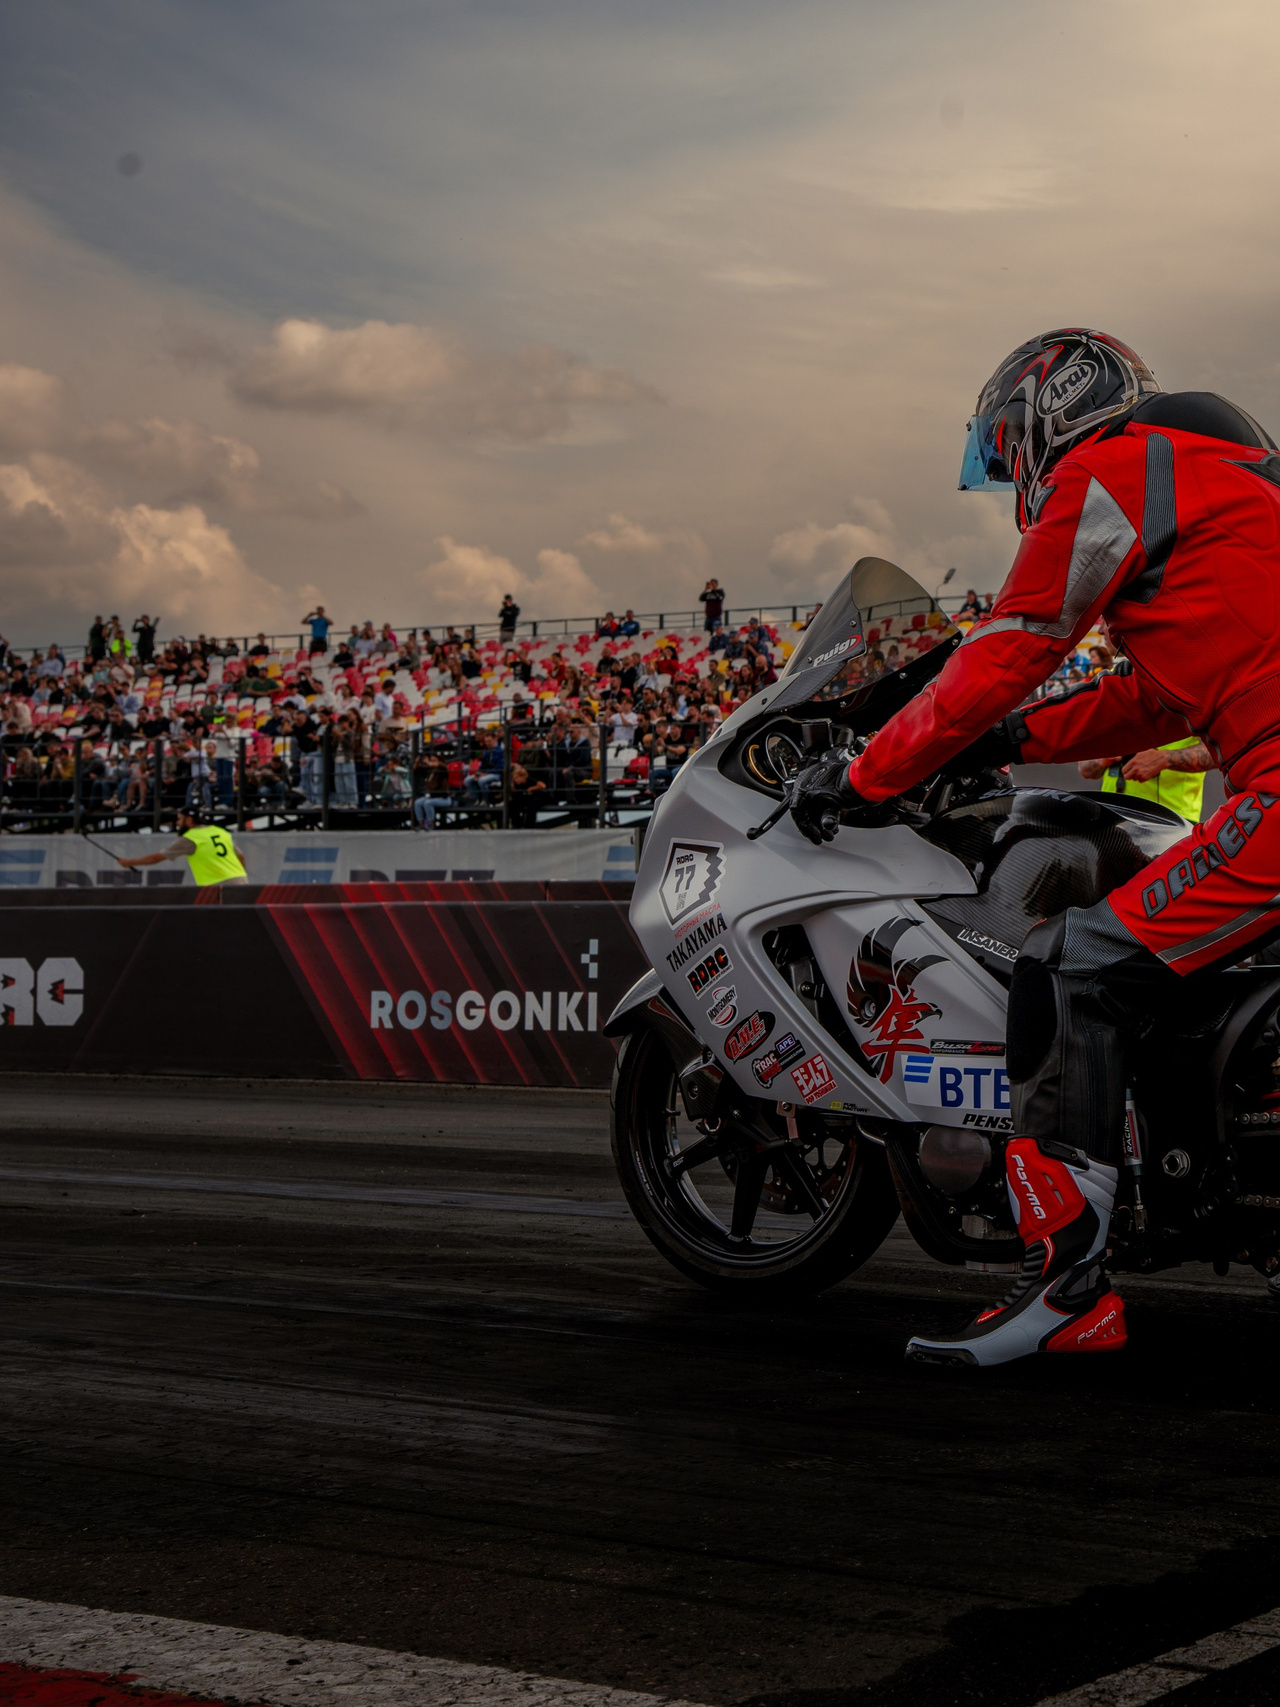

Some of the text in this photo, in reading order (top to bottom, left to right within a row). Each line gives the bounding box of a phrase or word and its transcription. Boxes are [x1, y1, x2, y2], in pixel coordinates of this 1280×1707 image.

[1047, 362, 1088, 412] Arai
[979, 787, 1077, 803] SUZUKI
[211, 835, 228, 857] 5
[675, 864, 696, 893] 77
[666, 912, 728, 972] TAKAYAMA
[687, 947, 729, 993] RDRC
[370, 990, 598, 1032] ROSGONKI
[708, 987, 736, 1020] MONTGOMERY
[728, 1014, 765, 1060] D.M.E.
[779, 1036, 796, 1053] APE
[756, 1053, 778, 1073] TRAC
[792, 1055, 831, 1097] ヨシムラ
[962, 1113, 1015, 1131] PENS
